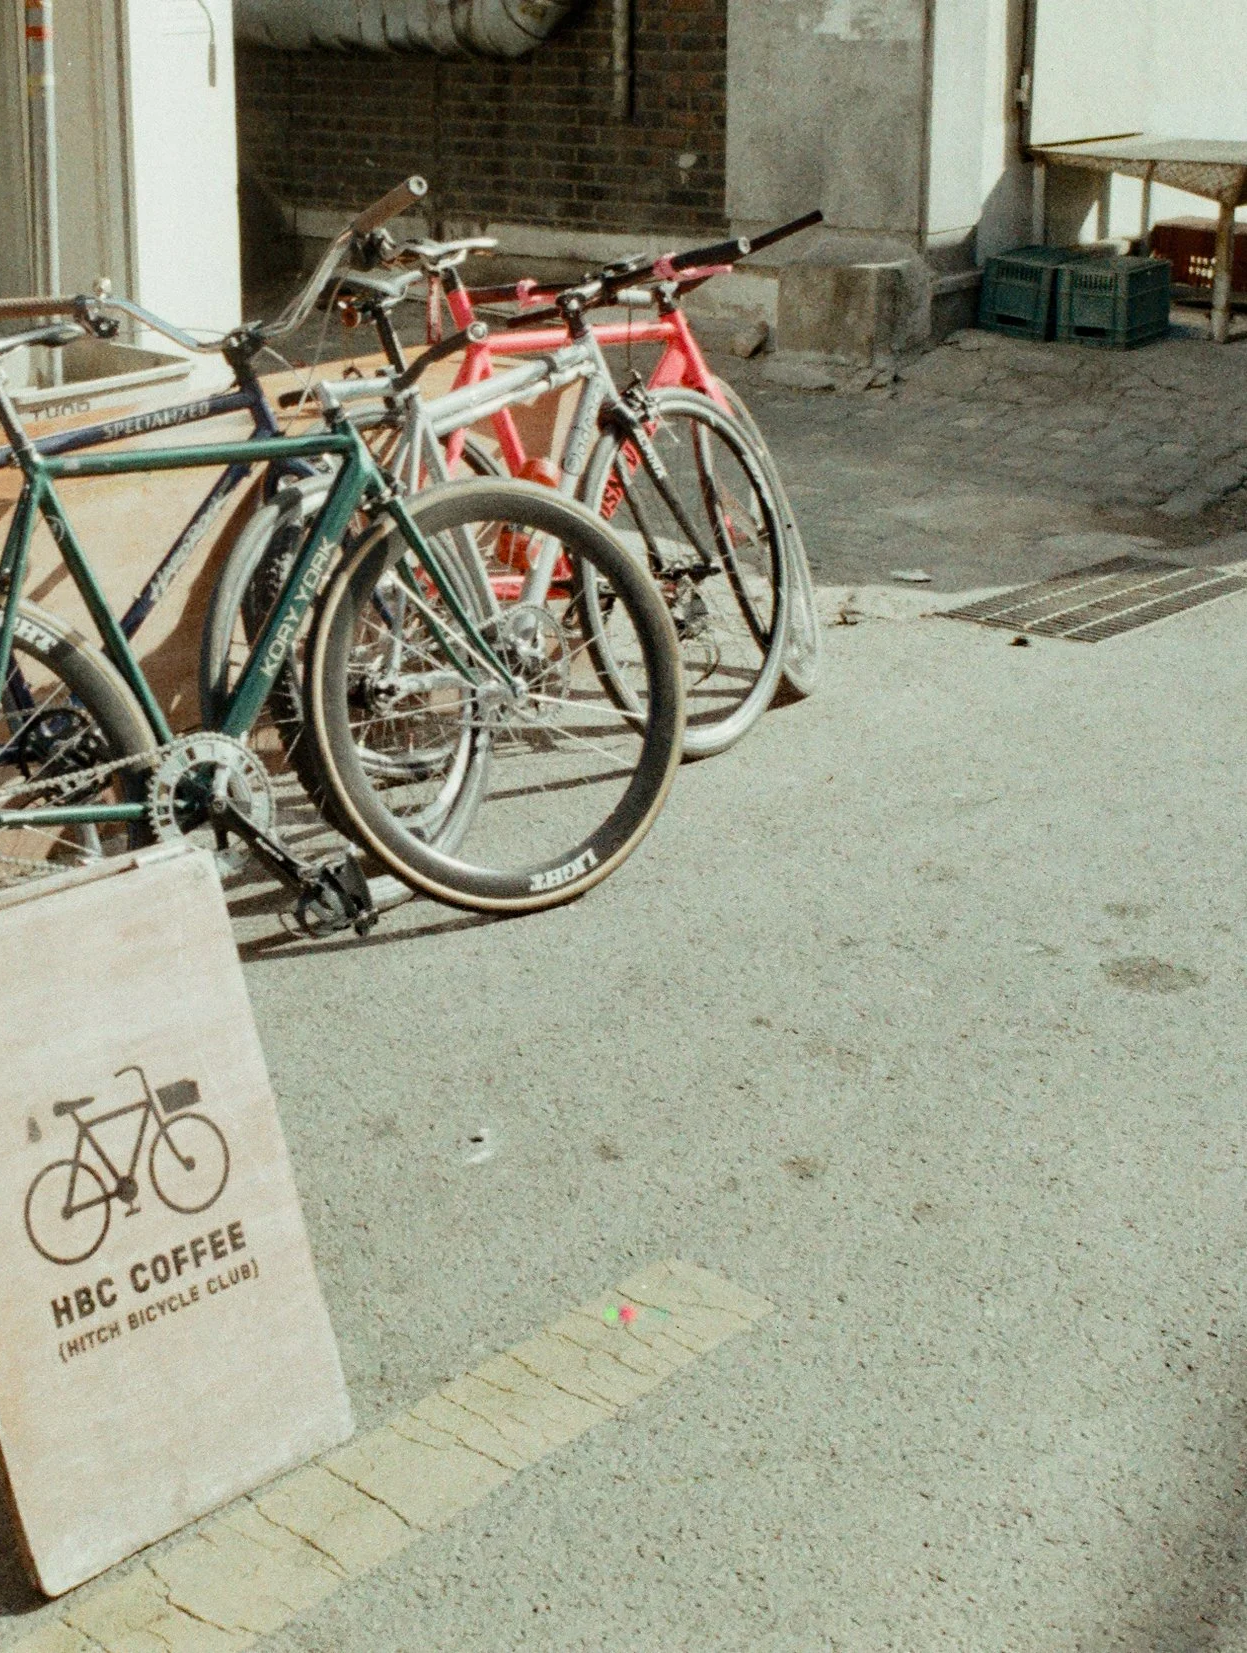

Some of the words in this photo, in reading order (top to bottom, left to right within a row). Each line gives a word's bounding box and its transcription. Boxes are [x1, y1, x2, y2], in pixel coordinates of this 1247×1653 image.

[260, 606, 301, 678] KORY
[297, 537, 340, 604] YORK
[51, 1277, 118, 1328] HBC
[130, 1220, 247, 1293] COFFEE
[58, 1321, 122, 1363] (HITCH
[128, 1284, 200, 1331] BICYCLE
[206, 1257, 259, 1296] CLUB)
